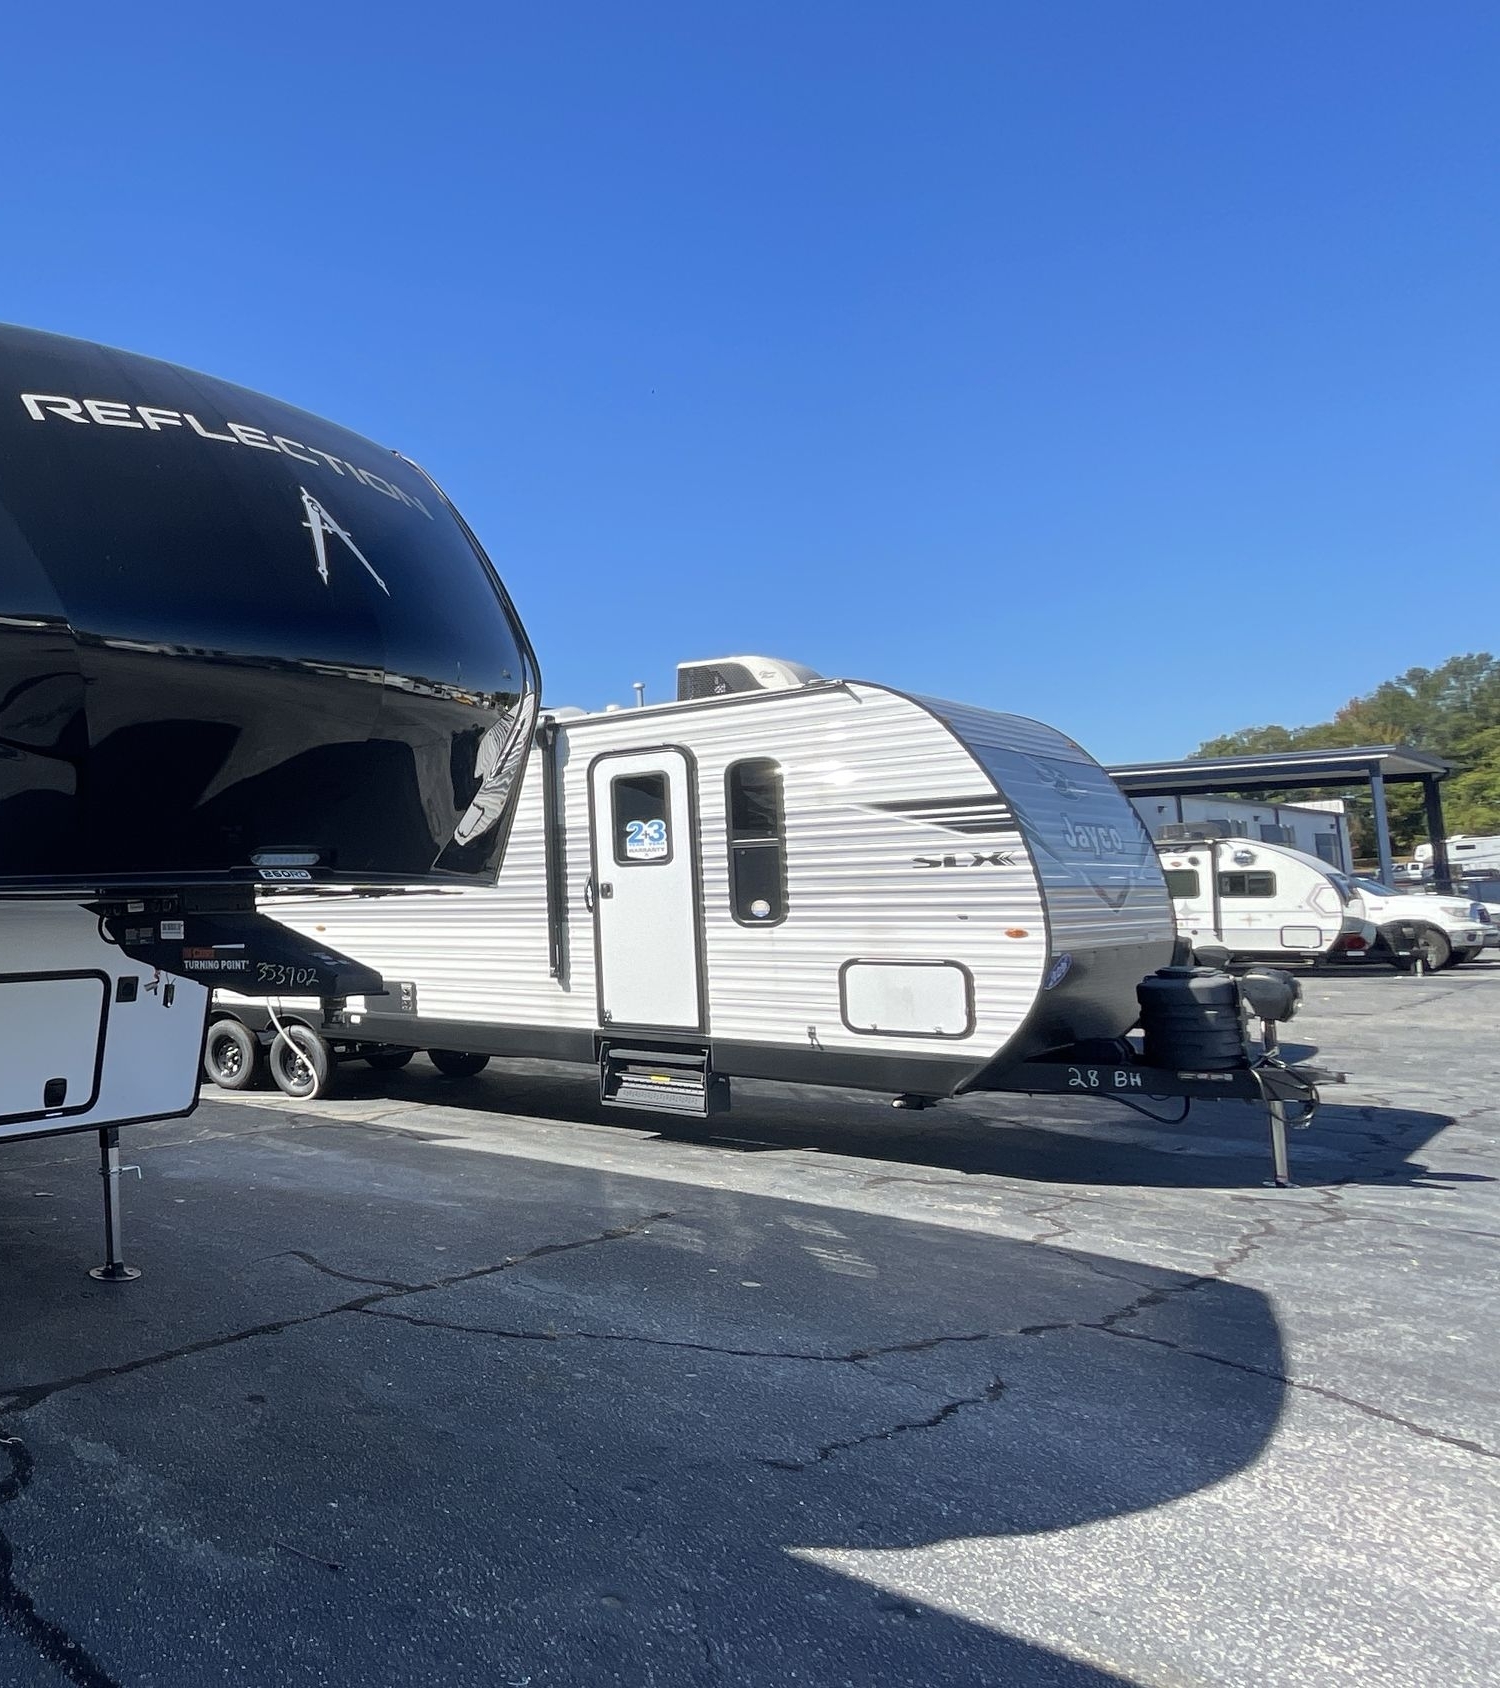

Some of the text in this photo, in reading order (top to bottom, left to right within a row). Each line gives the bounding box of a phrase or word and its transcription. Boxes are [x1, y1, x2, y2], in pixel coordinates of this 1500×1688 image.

[19, 392, 434, 521] REFLECTION
[1060, 812, 1123, 856] Jayco
[911, 851, 1012, 869] SLX
[184, 960, 220, 970] TURNING
[1068, 1067, 1142, 1088] 28 BH
